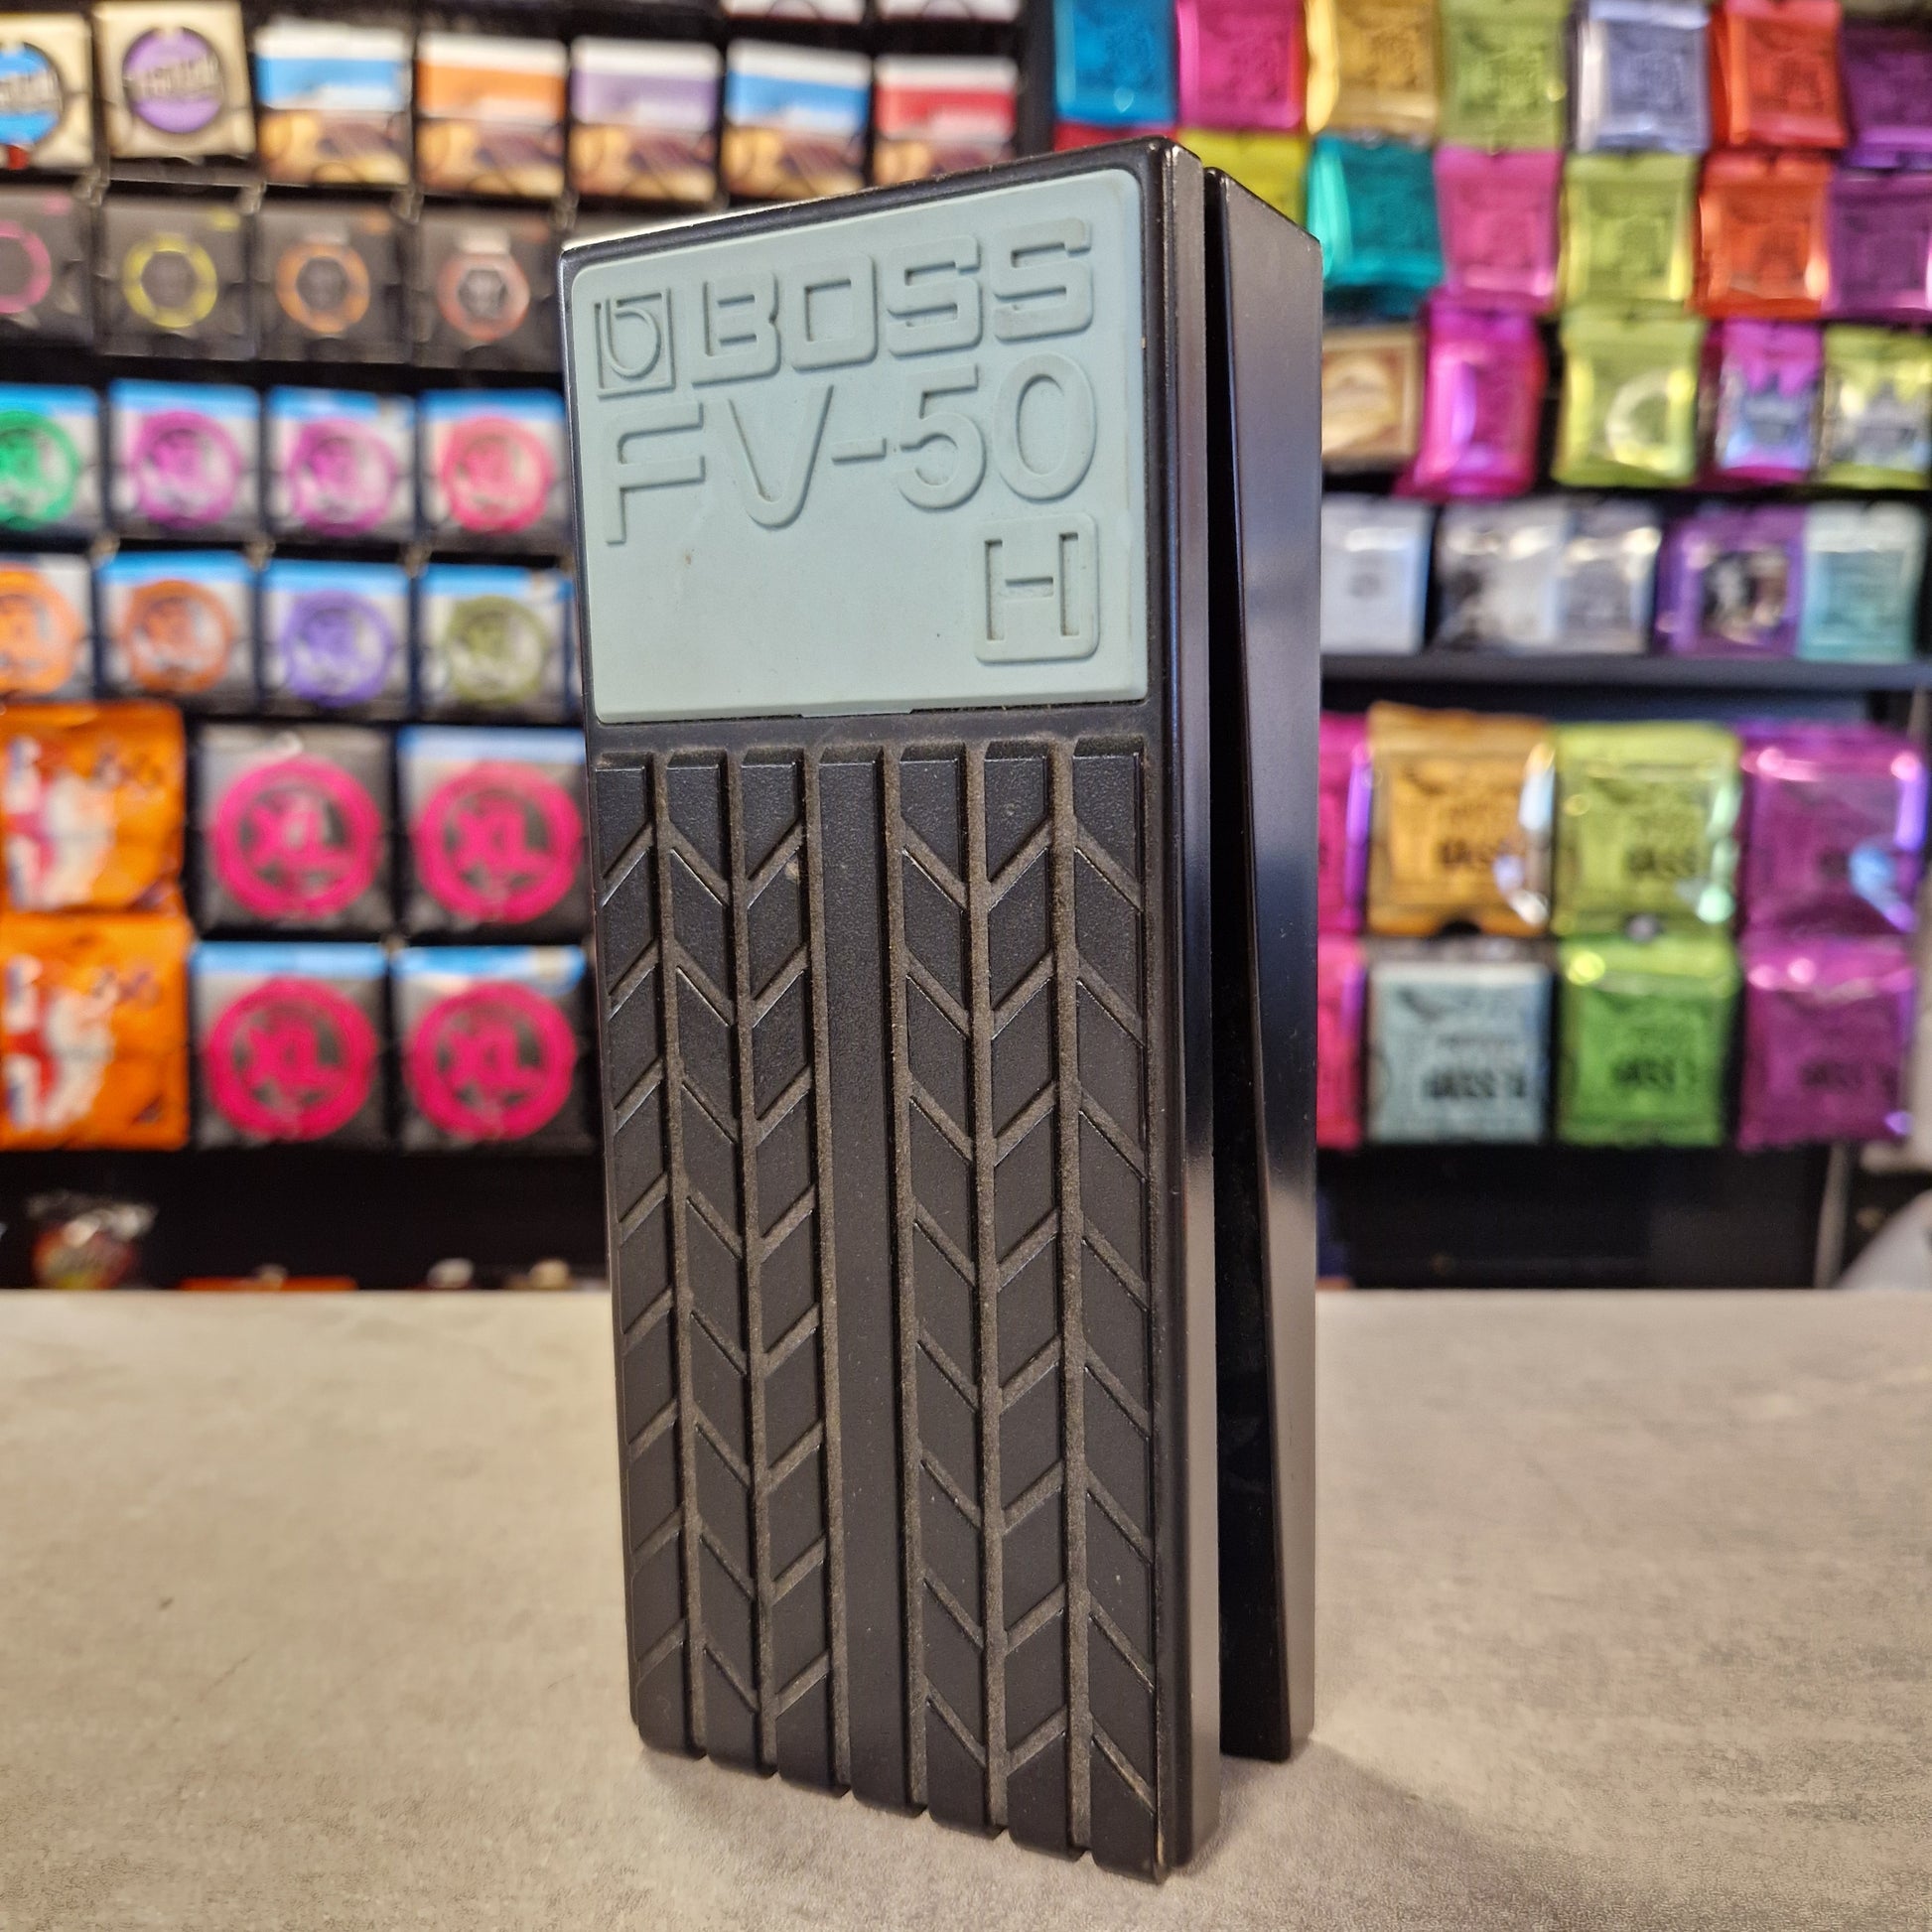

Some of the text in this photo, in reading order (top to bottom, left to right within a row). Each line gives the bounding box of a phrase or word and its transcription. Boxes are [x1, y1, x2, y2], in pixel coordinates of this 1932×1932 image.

[693, 217, 1093, 390] BOSS
[599, 351, 1098, 546] FV-50
[981, 529, 1082, 643] H
